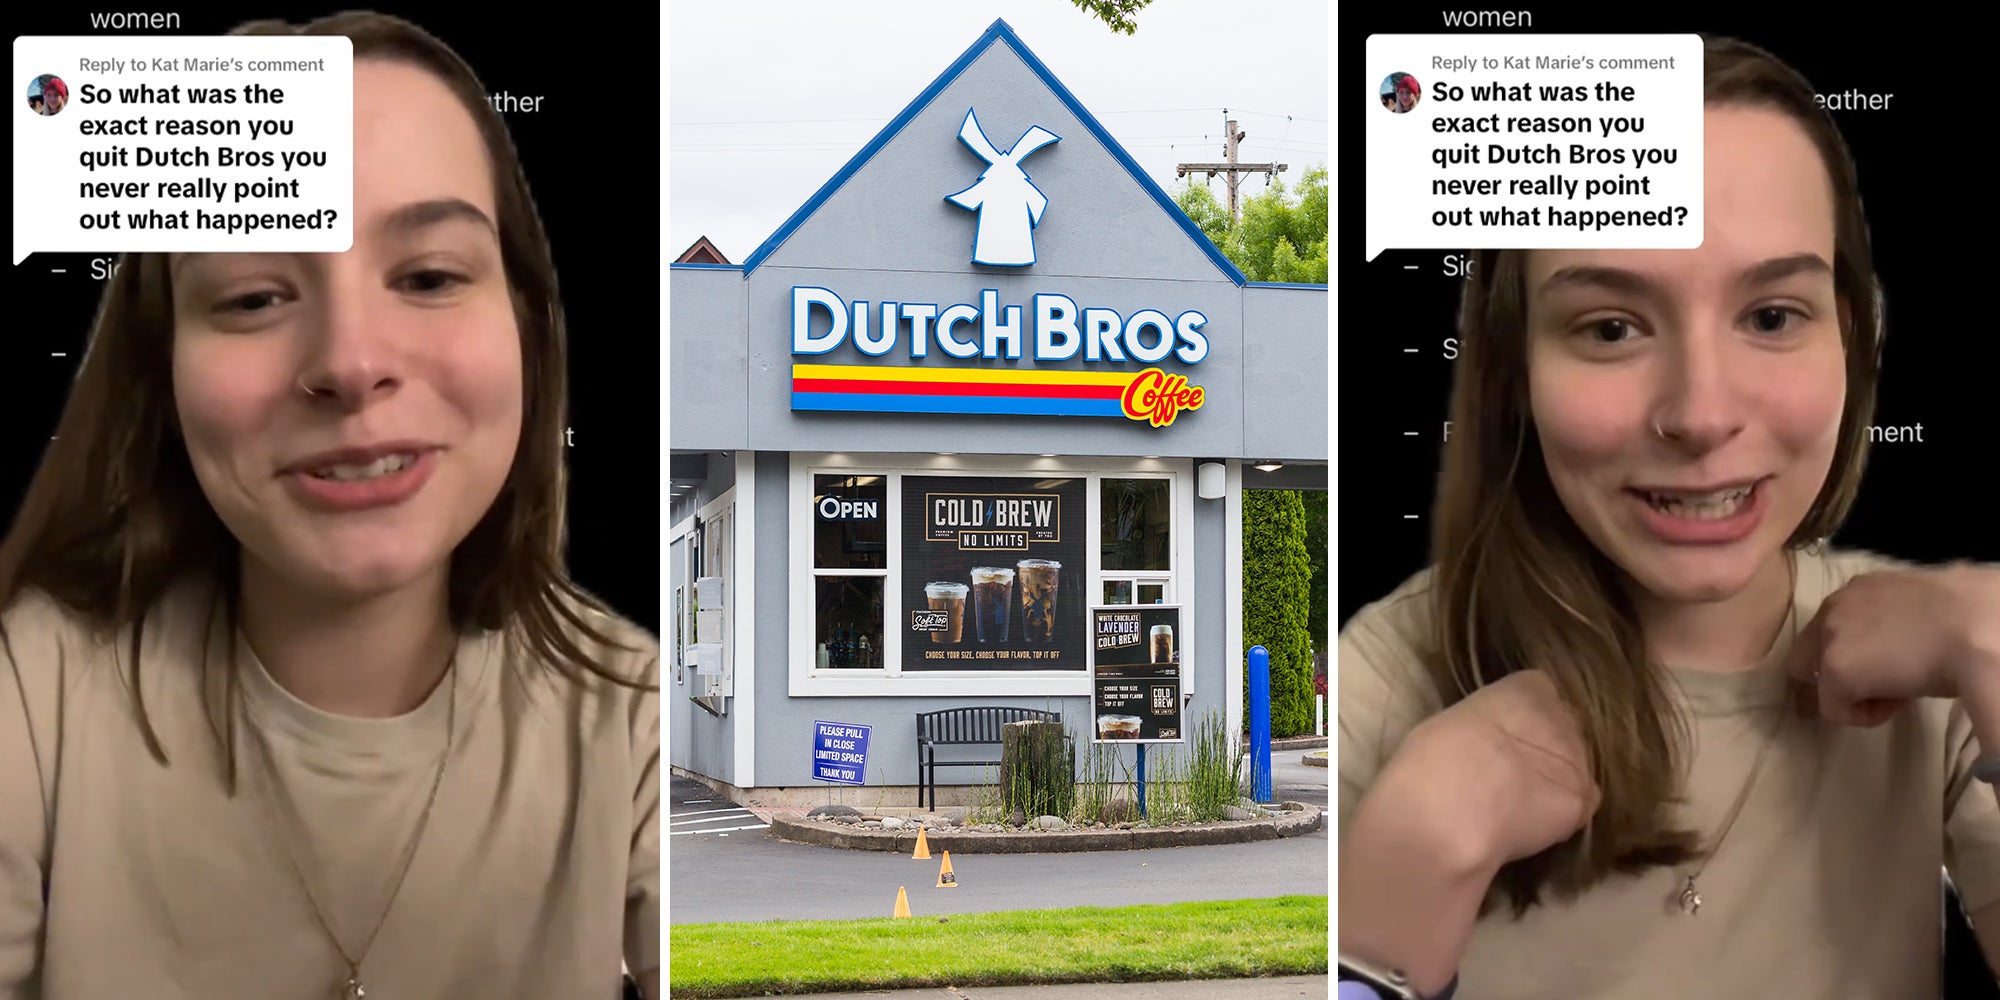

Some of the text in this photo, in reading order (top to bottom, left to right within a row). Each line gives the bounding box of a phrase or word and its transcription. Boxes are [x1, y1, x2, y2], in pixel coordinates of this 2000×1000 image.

[791, 286, 1209, 364] DUTCH BROS
[1124, 369, 1203, 425] Coffee
[820, 498, 877, 519] OPEN
[935, 499, 1053, 527] COLD BREW
[963, 534, 1023, 547] NO LIMITS
[1098, 622, 1139, 633] LAVENDER
[1098, 633, 1139, 648] COLD BREW
[925, 651, 945, 659] CHOOSE
[946, 651, 960, 659] YOUR
[976, 651, 995, 659] CHOOSE
[996, 651, 1010, 659] YOUR
[1033, 651, 1043, 659] TOP
[1044, 651, 1049, 659] IT
[1050, 651, 1061, 659] OFF
[1153, 688, 1170, 698] COLD
[1153, 698, 1174, 708] BREW
[820, 725, 863, 739] PLEASE PULL
[825, 739, 855, 750] IN CLOSE
[815, 750, 864, 764] LIMITED SPACE
[820, 767, 855, 780] THANK YOU
